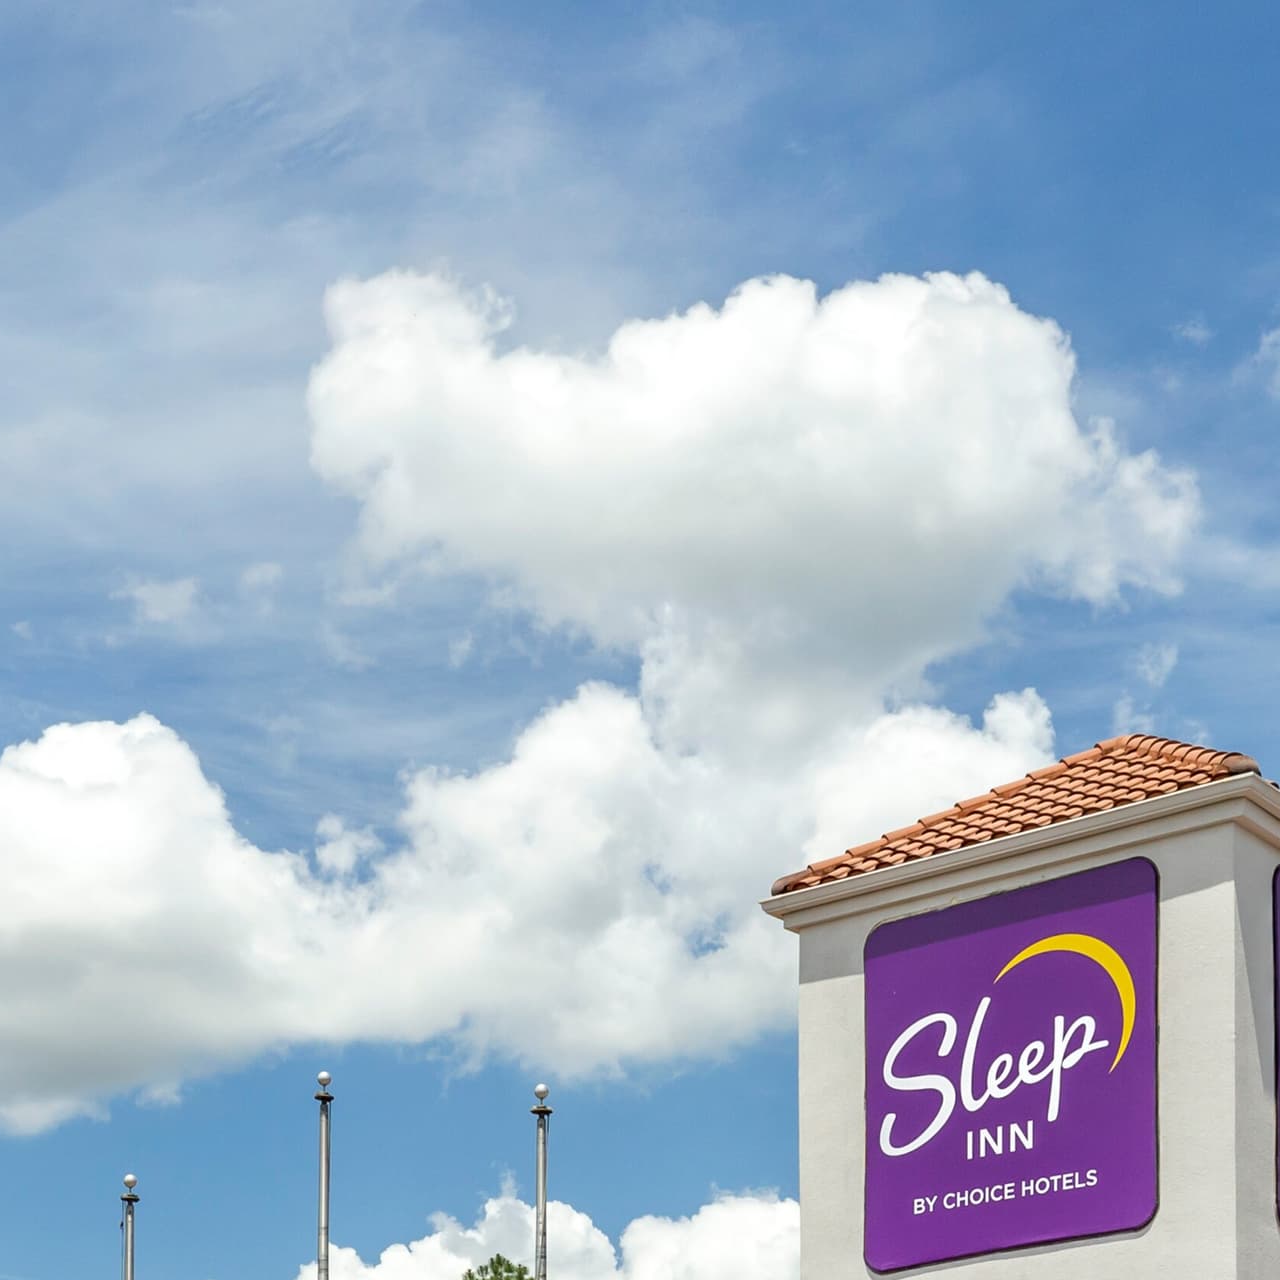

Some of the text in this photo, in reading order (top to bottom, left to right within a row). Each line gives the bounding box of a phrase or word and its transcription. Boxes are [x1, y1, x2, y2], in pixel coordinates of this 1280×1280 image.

[879, 996, 1110, 1158] Sleep
[966, 1119, 1034, 1160] INN
[913, 1169, 1099, 1215] BY CHOICE HOTELS
